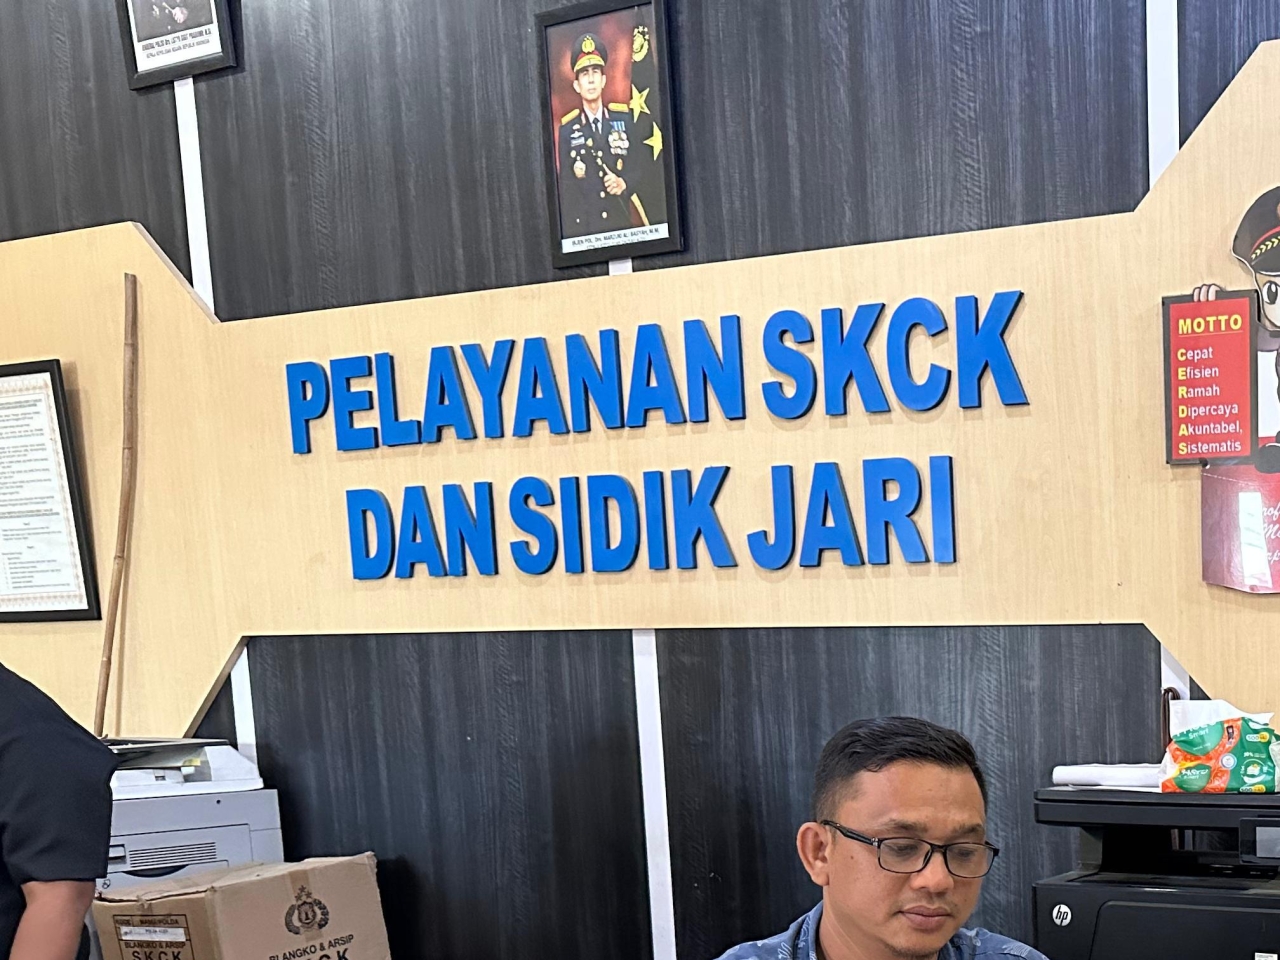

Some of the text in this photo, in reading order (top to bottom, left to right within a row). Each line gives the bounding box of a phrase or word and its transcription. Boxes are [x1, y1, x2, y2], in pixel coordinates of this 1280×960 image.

[1178, 314, 1243, 335] MOTTO
[1177, 346, 1213, 363] Cepat
[285, 290, 1030, 454] PELAYANAN SKCK
[1178, 366, 1219, 380] Efisien
[1178, 384, 1220, 398] Ramah
[1178, 403, 1239, 419] Dipercaya
[1178, 421, 1243, 436] Akuntabel,
[1178, 440, 1242, 455] Sistematis
[345, 455, 958, 580] DAN SIDIK JARI
[1055, 905, 1069, 926] hp
[165, 941, 186, 949] ARSIP
[319, 943, 326, 951] &
[328, 934, 354, 950] ARSIP
